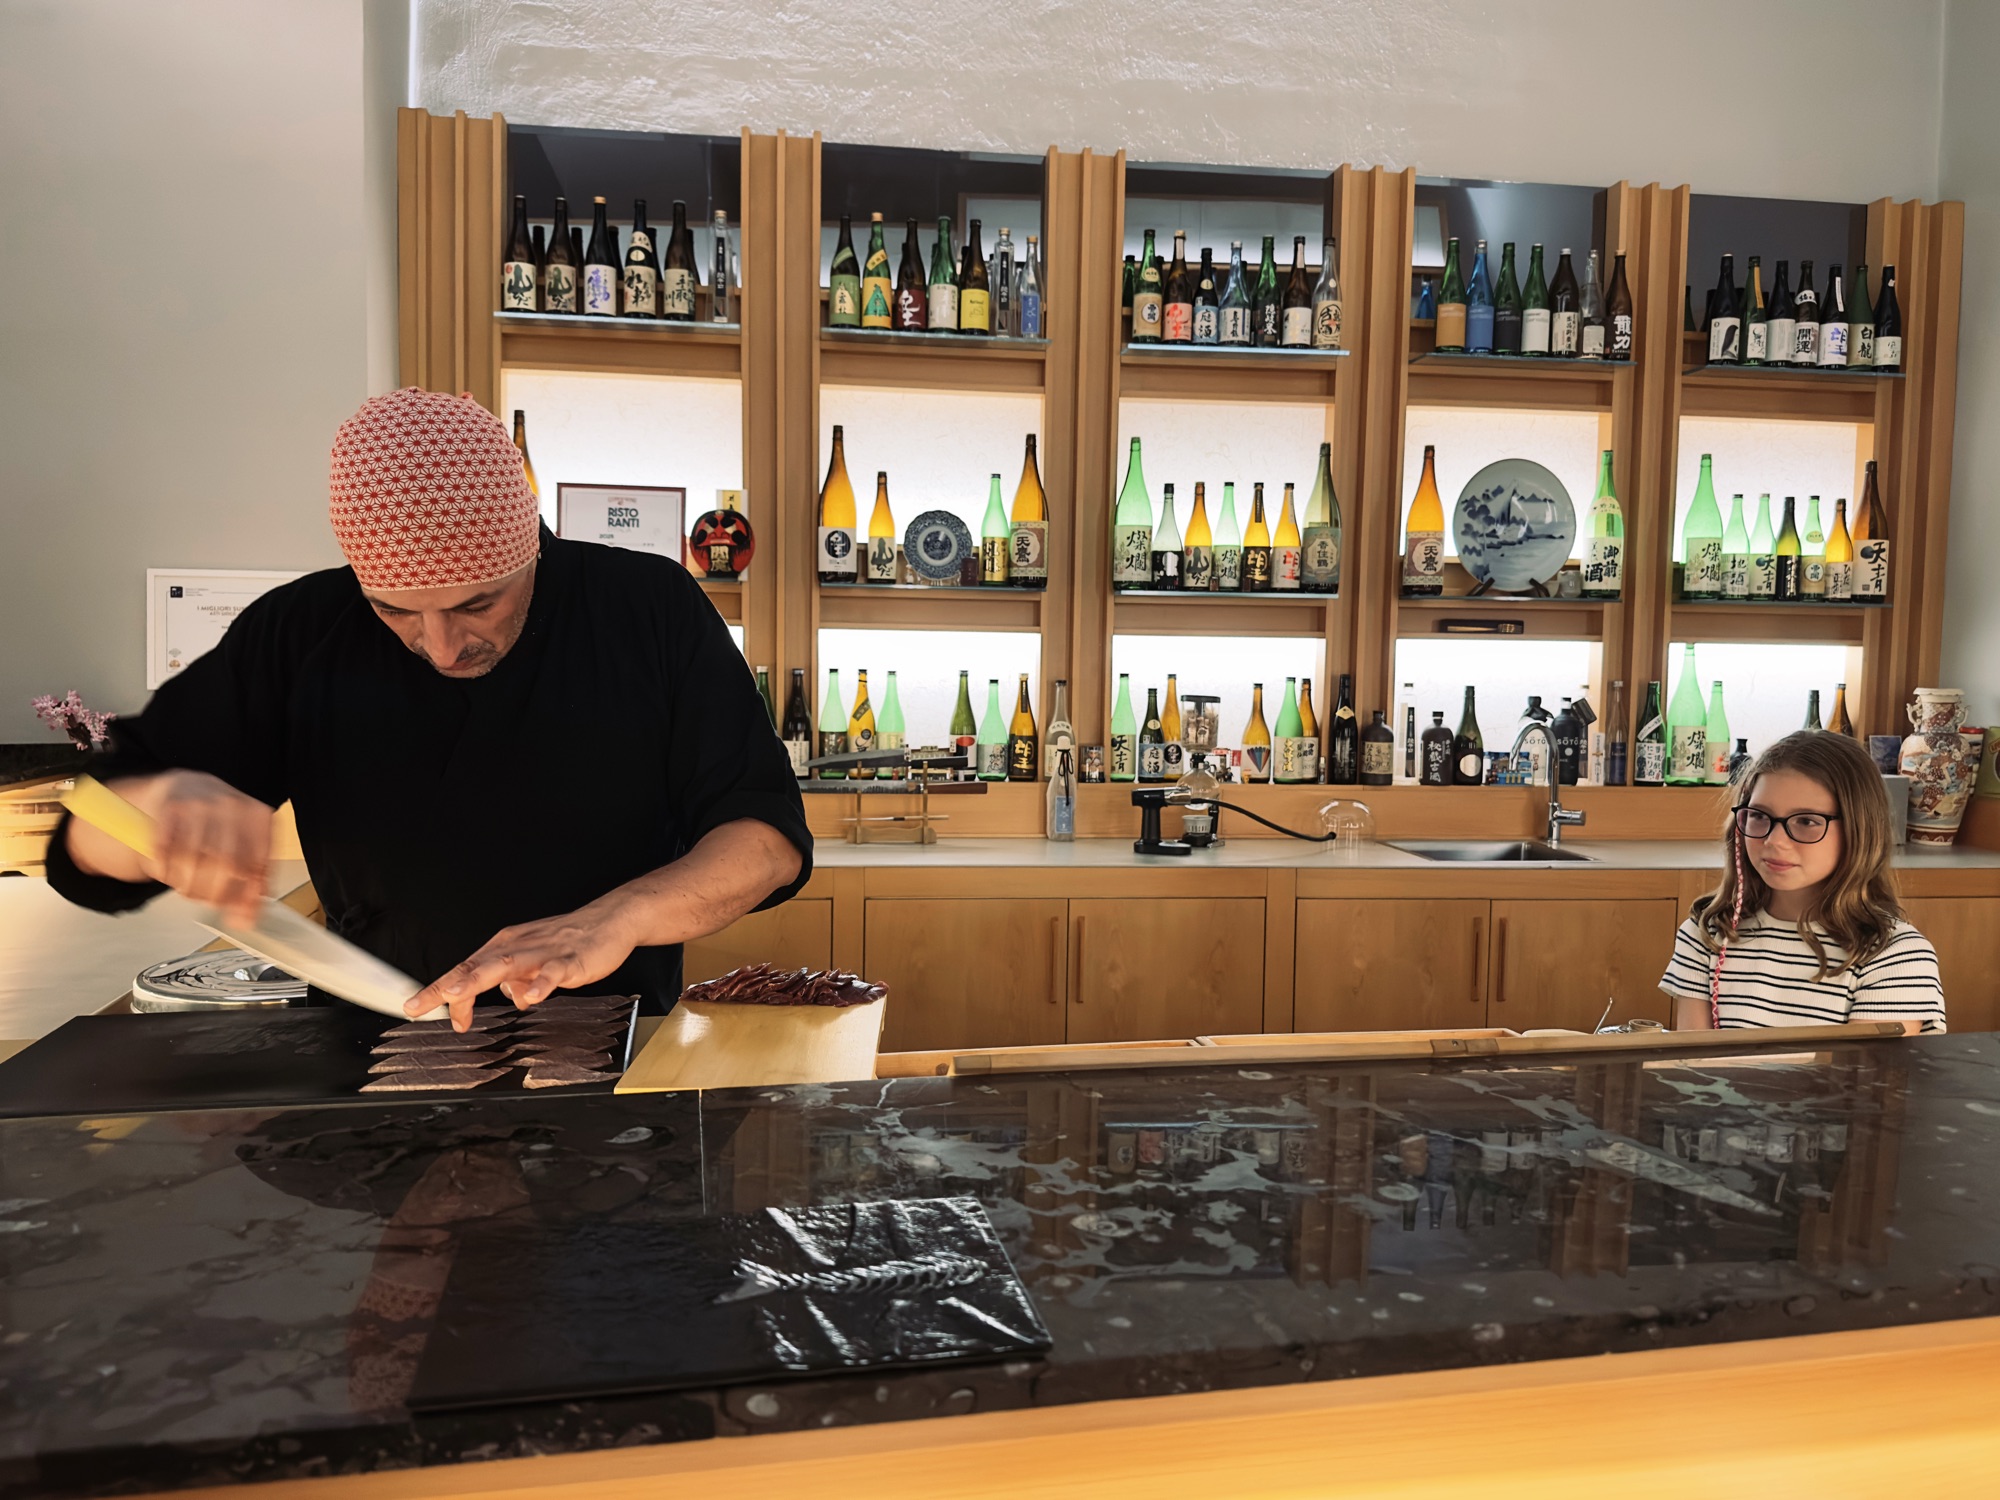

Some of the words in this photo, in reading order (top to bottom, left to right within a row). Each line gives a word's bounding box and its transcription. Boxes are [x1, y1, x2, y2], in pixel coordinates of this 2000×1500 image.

[1796, 328, 1812, 354] 開運
[1858, 326, 1873, 359] 白龍
[608, 507, 639, 518] RISTO
[608, 518, 640, 528] RANTI
[1125, 530, 1148, 572] 燦爛
[1867, 541, 1888, 593] 天青
[1730, 554, 1747, 586] 地酒
[1112, 734, 1132, 773] 天青
[1686, 730, 1706, 769] 燦爛
